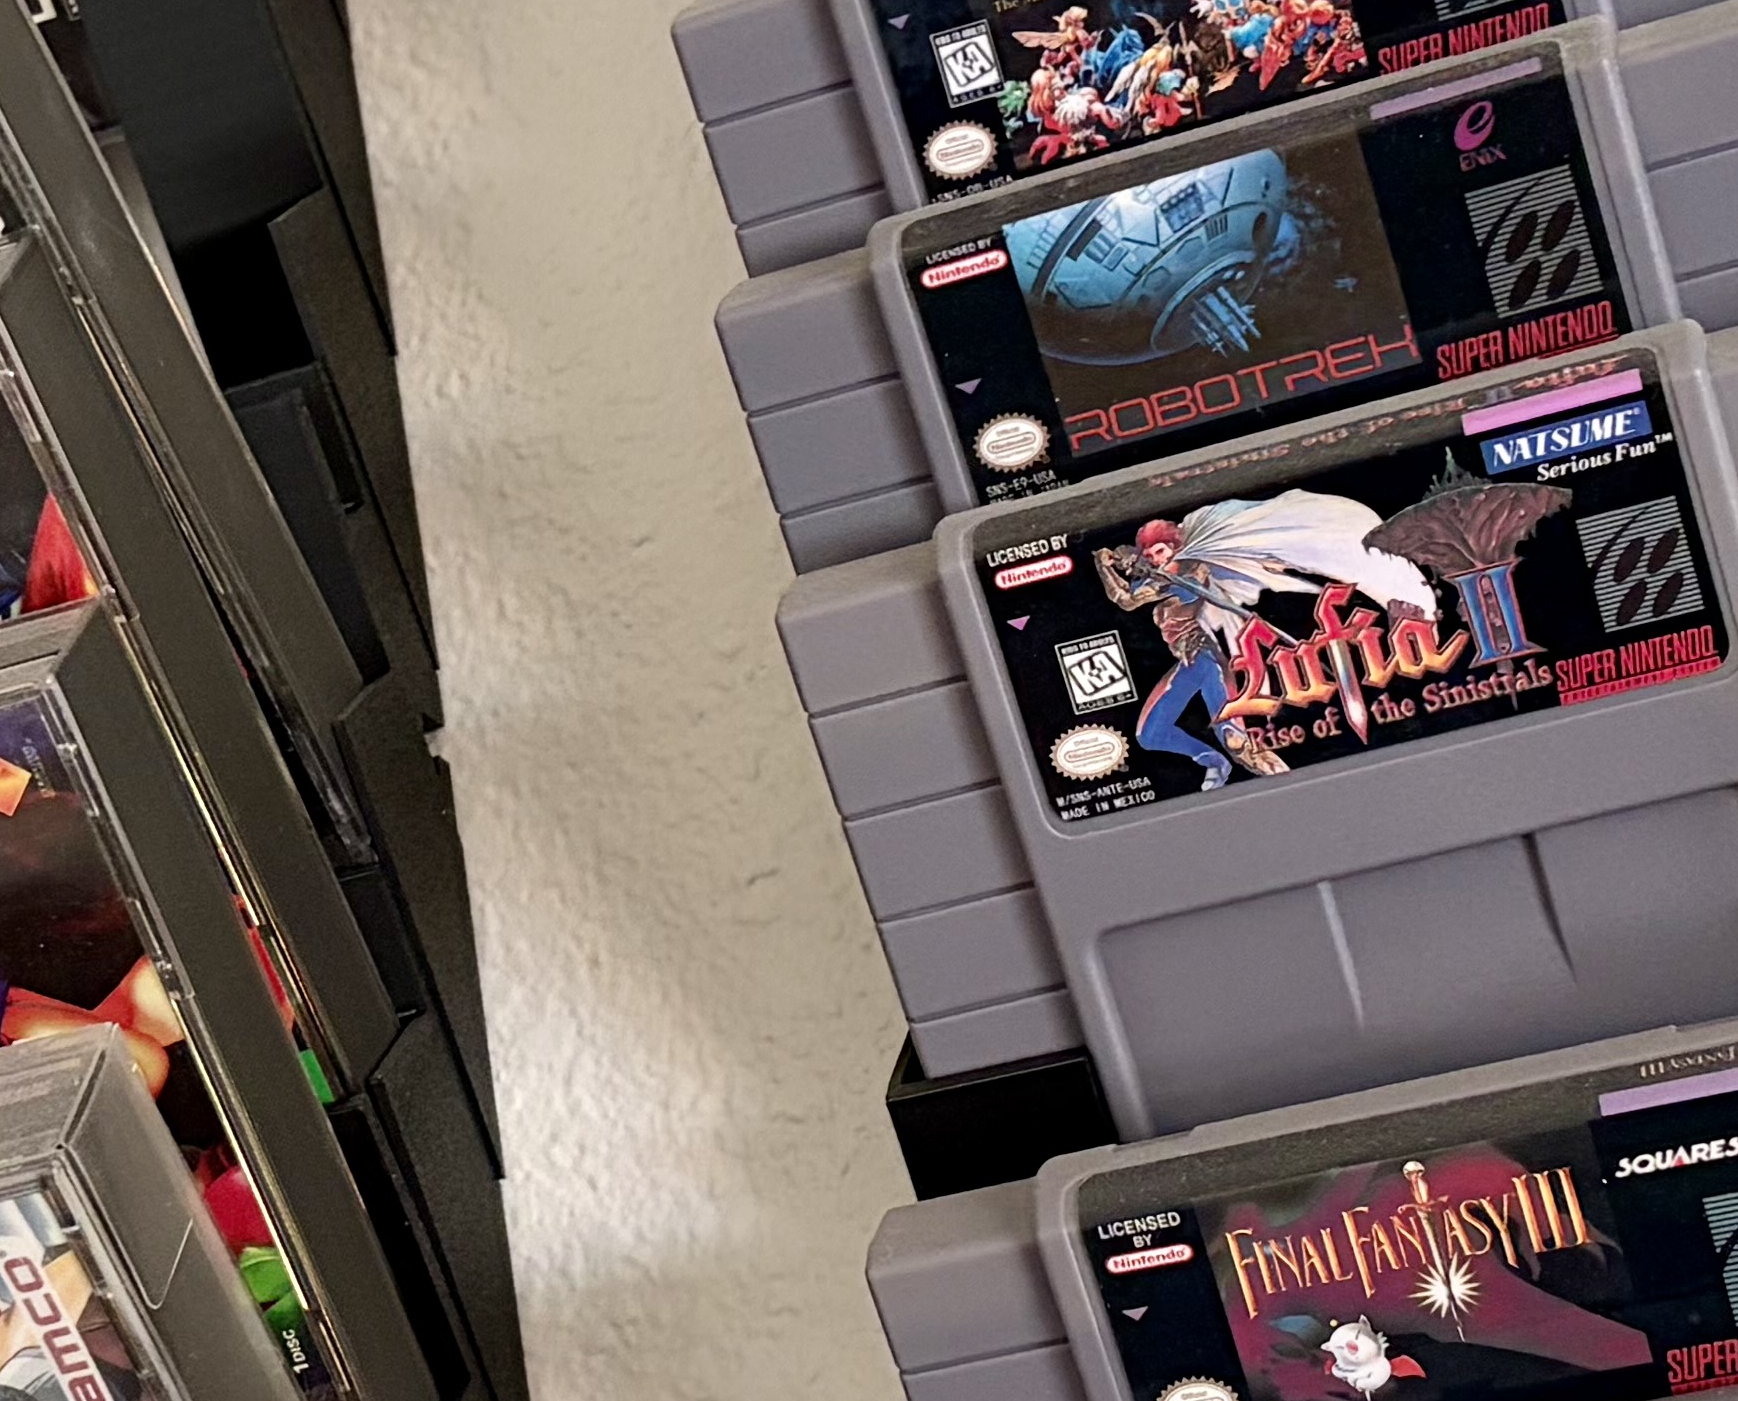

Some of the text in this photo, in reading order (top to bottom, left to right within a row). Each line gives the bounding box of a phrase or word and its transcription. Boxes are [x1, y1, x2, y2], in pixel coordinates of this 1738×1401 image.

[1378, 2, 1552, 76] SUPER NINTENDO
[1459, 147, 1506, 171] ENIX
[925, 238, 993, 265] LICENSED BY
[927, 253, 1001, 286] Nintendo
[1436, 300, 1615, 380] SUPER NINTENDO
[1065, 324, 1419, 450] ROBOTREK
[1491, 410, 1637, 466] NATSUME
[985, 468, 1057, 498] SNS-E9-USA
[1536, 449, 1612, 483] Serious
[986, 533, 1069, 567] LICENSED BY
[1000, 559, 1067, 586] Nintendo
[1212, 558, 1549, 724] Lufia II
[1555, 648, 1616, 693] SUPER
[1620, 625, 1719, 676] NINTENDO
[1247, 721, 1305, 754] Rise
[1312, 706, 1340, 736] of
[1370, 692, 1417, 722] the
[1422, 660, 1554, 713] Sinistrals
[1060, 790, 1156, 822] MADE IN MEXICO
[1097, 1211, 1182, 1240] LICENSED
[1132, 1233, 1153, 1249] BY
[1113, 1247, 1186, 1270] Nintendo
[1225, 1166, 1592, 1320] FINAL FANTASY III
